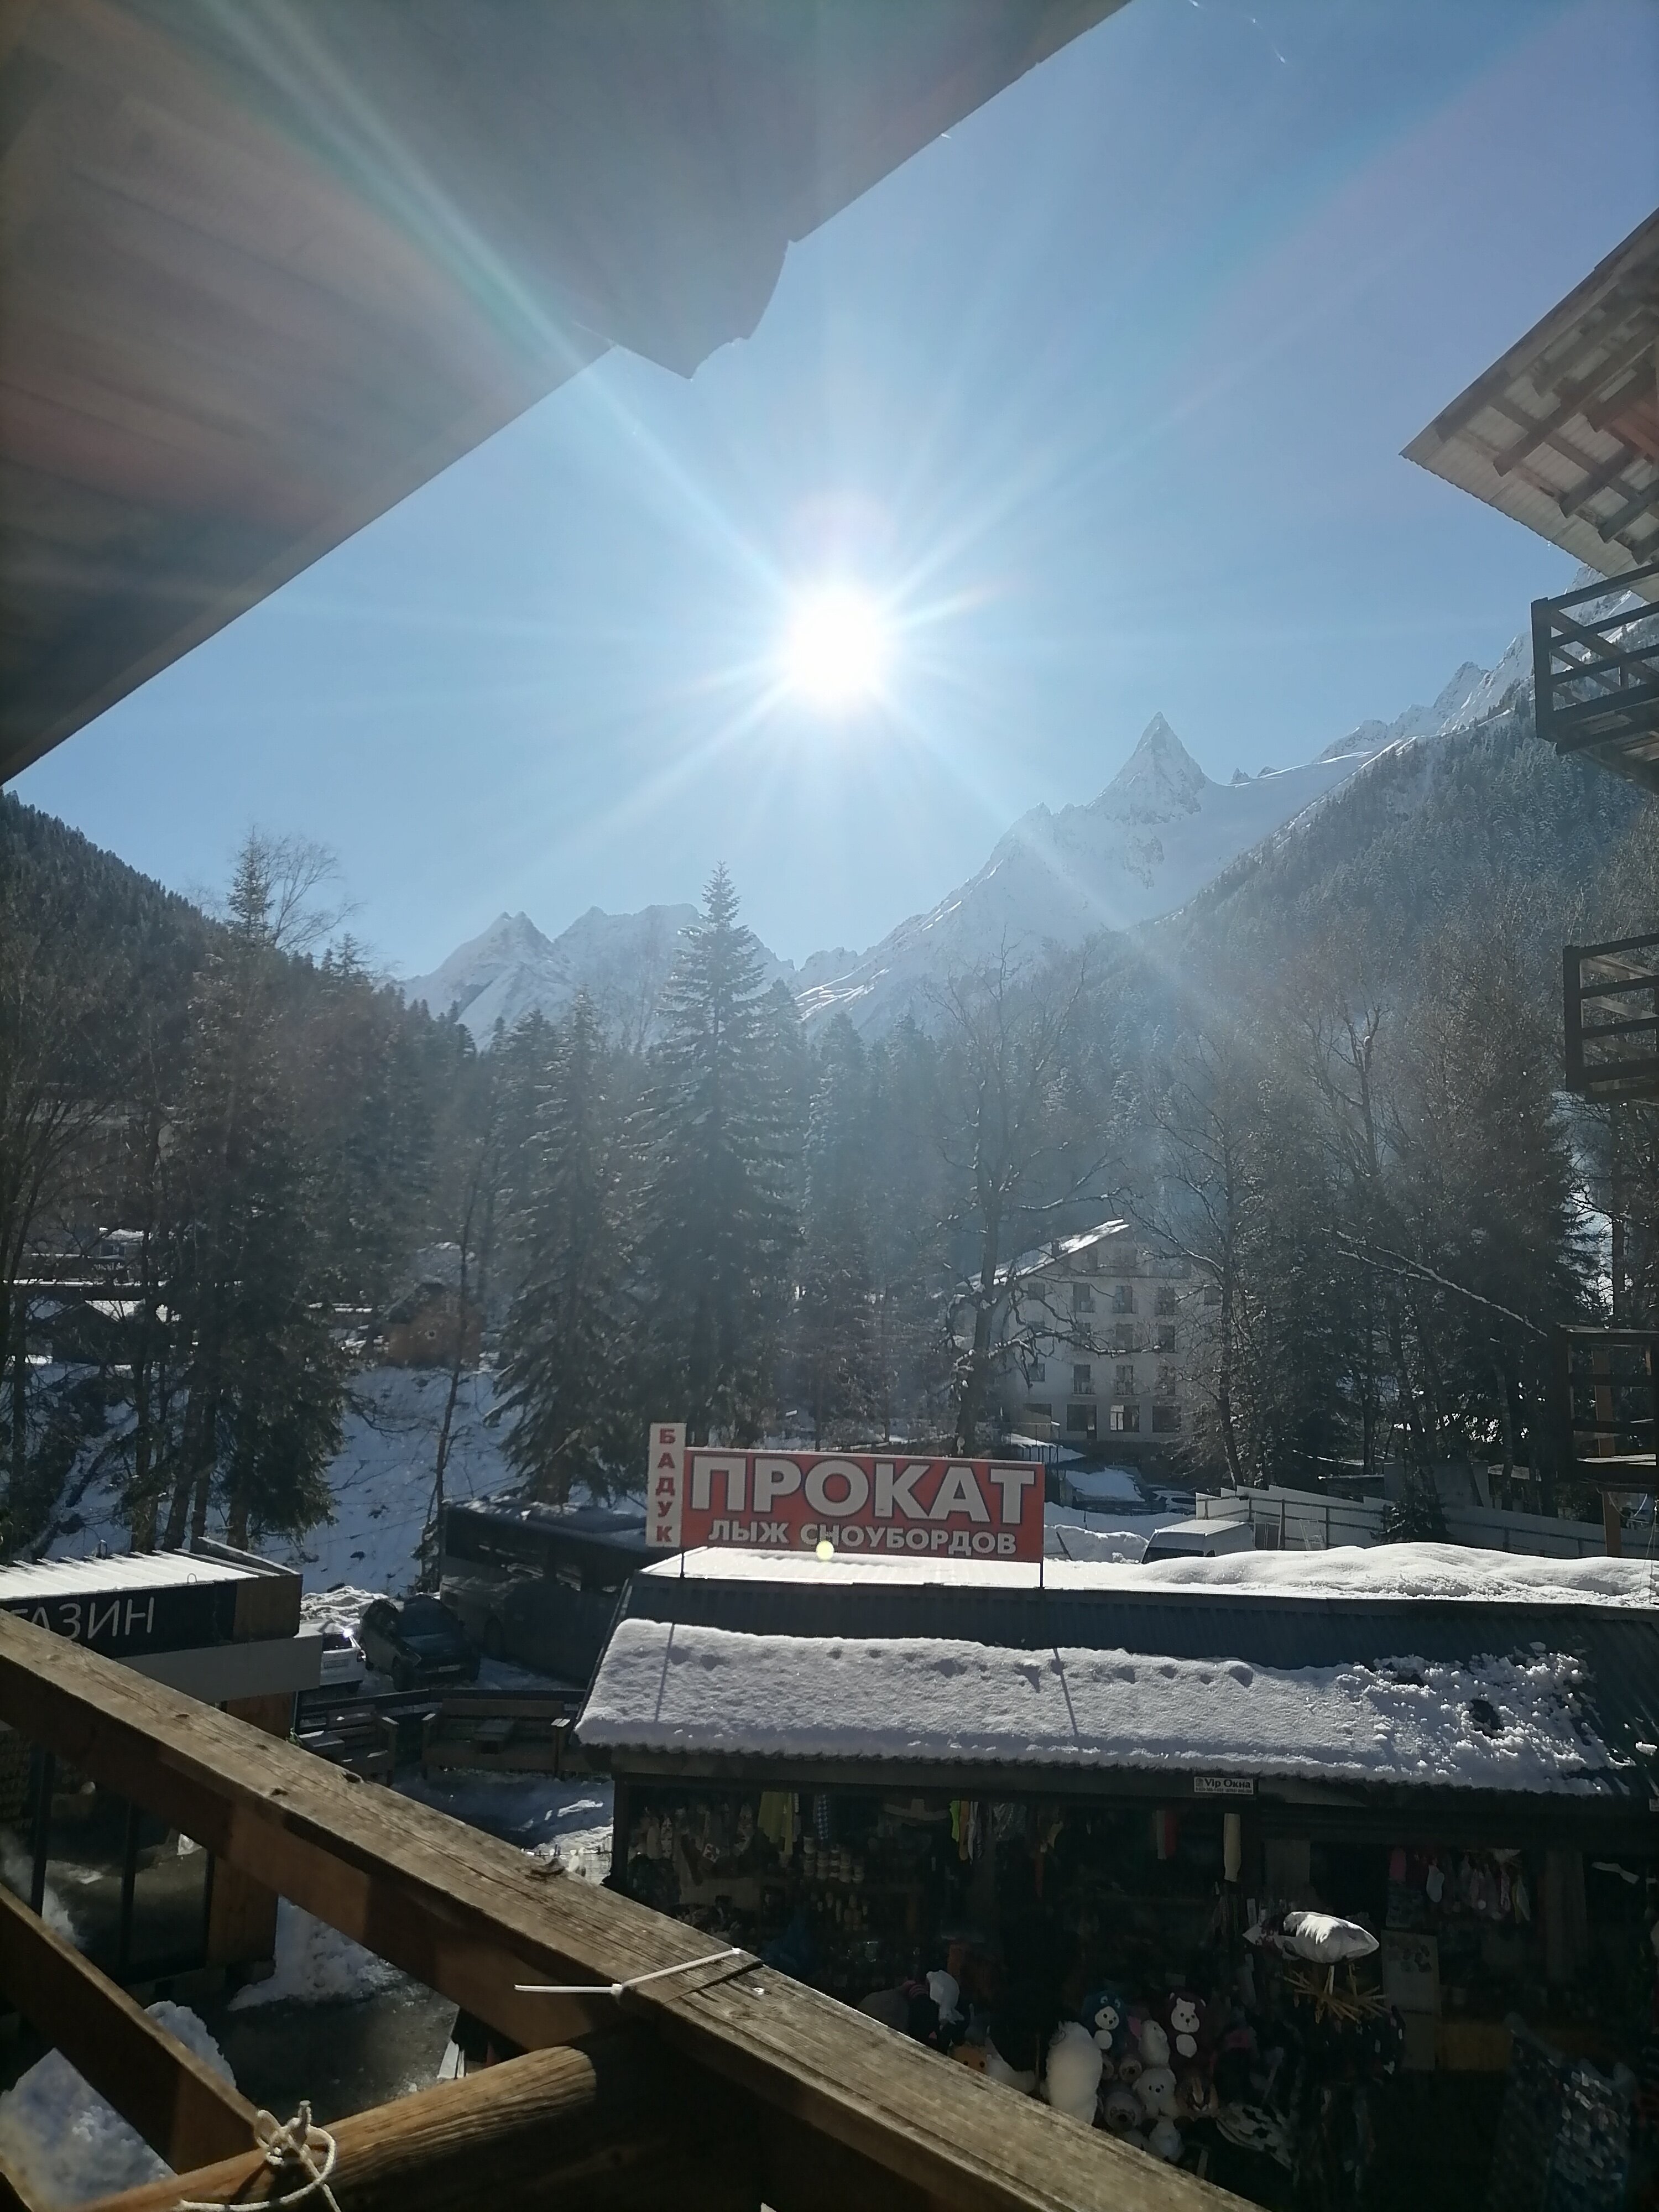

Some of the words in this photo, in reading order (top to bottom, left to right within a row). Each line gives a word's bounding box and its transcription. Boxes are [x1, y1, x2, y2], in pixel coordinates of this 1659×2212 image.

[656, 1428, 675, 1542] БАДУК
[691, 1455, 1035, 1524] ПРОКАТ
[709, 1519, 789, 1545] ЛЫЖ
[800, 1524, 1016, 1556] СНОУБОРДОВ
[10, 1597, 154, 1640] АЗИН
[1204, 1778, 1221, 1788] Vip
[1223, 1779, 1251, 1788] Окна
